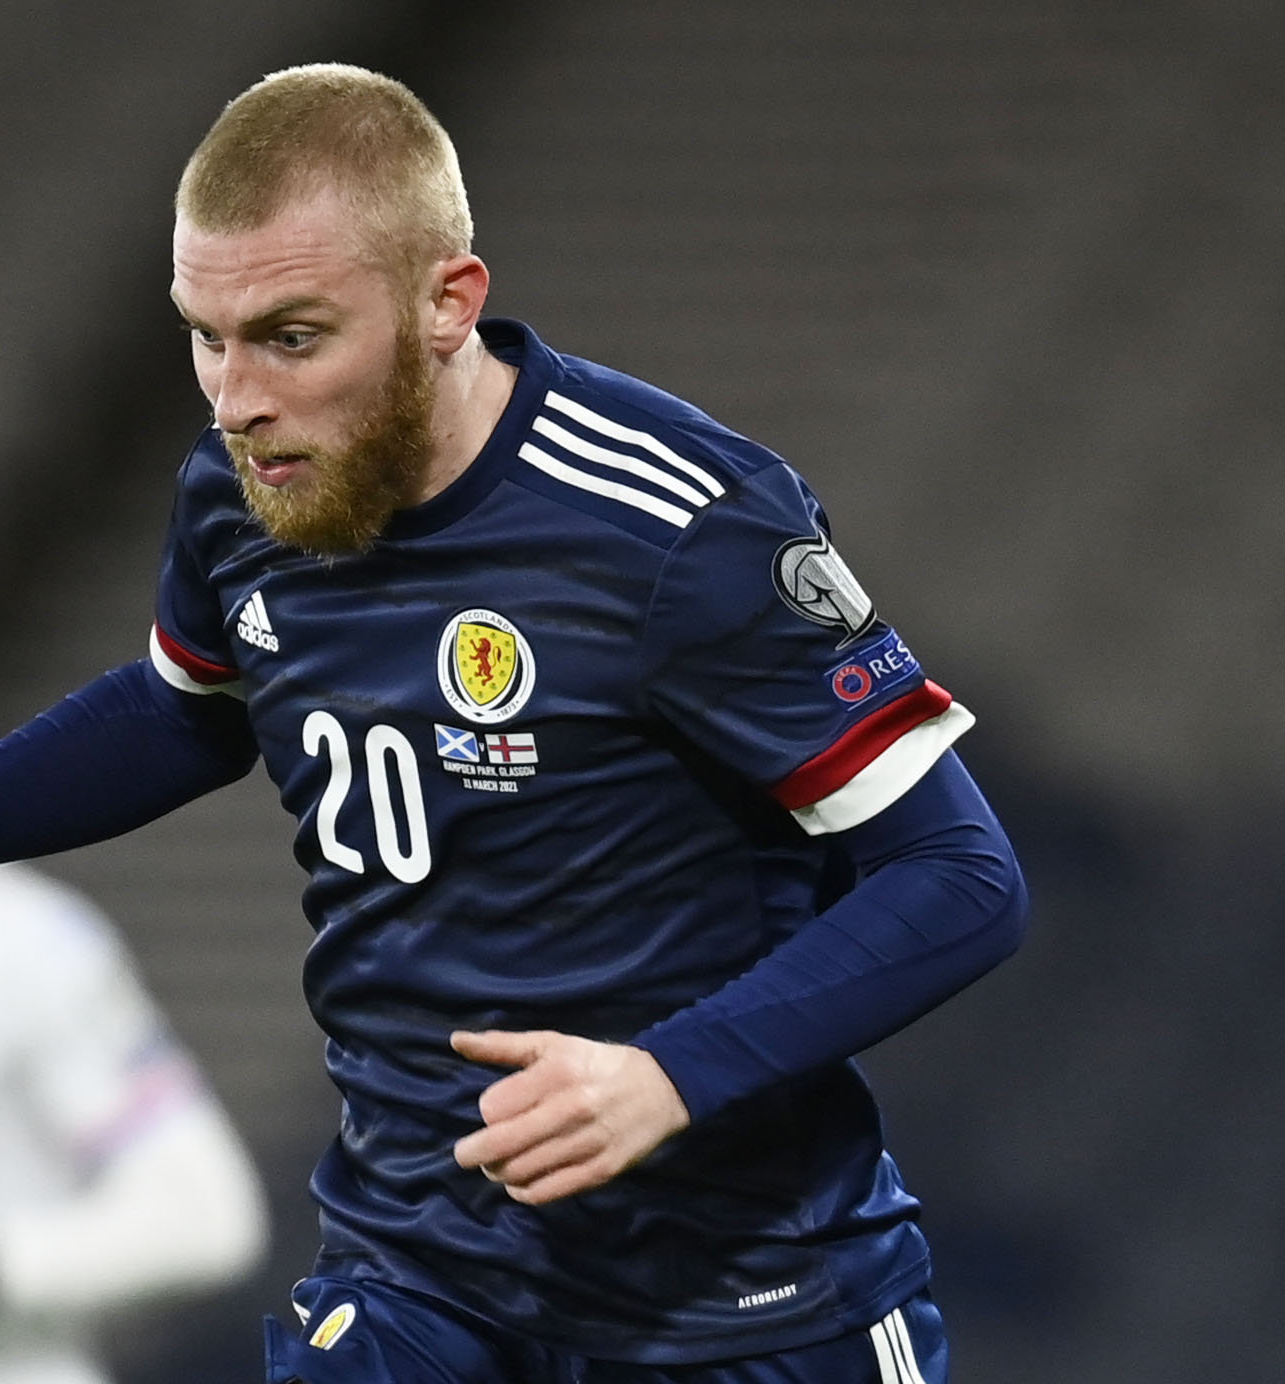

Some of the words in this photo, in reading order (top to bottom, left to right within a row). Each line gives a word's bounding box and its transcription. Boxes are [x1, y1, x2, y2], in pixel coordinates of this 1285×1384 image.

[463, 611, 510, 631] SCOTLAND
[237, 621, 280, 653] adidas
[445, 688, 459, 704] EST
[500, 702, 518, 717] 1873
[472, 779, 499, 792] MARCH
[499, 780, 519, 793] 2021
[302, 710, 432, 884] 20
[738, 1283, 798, 1310] AEROREADY
